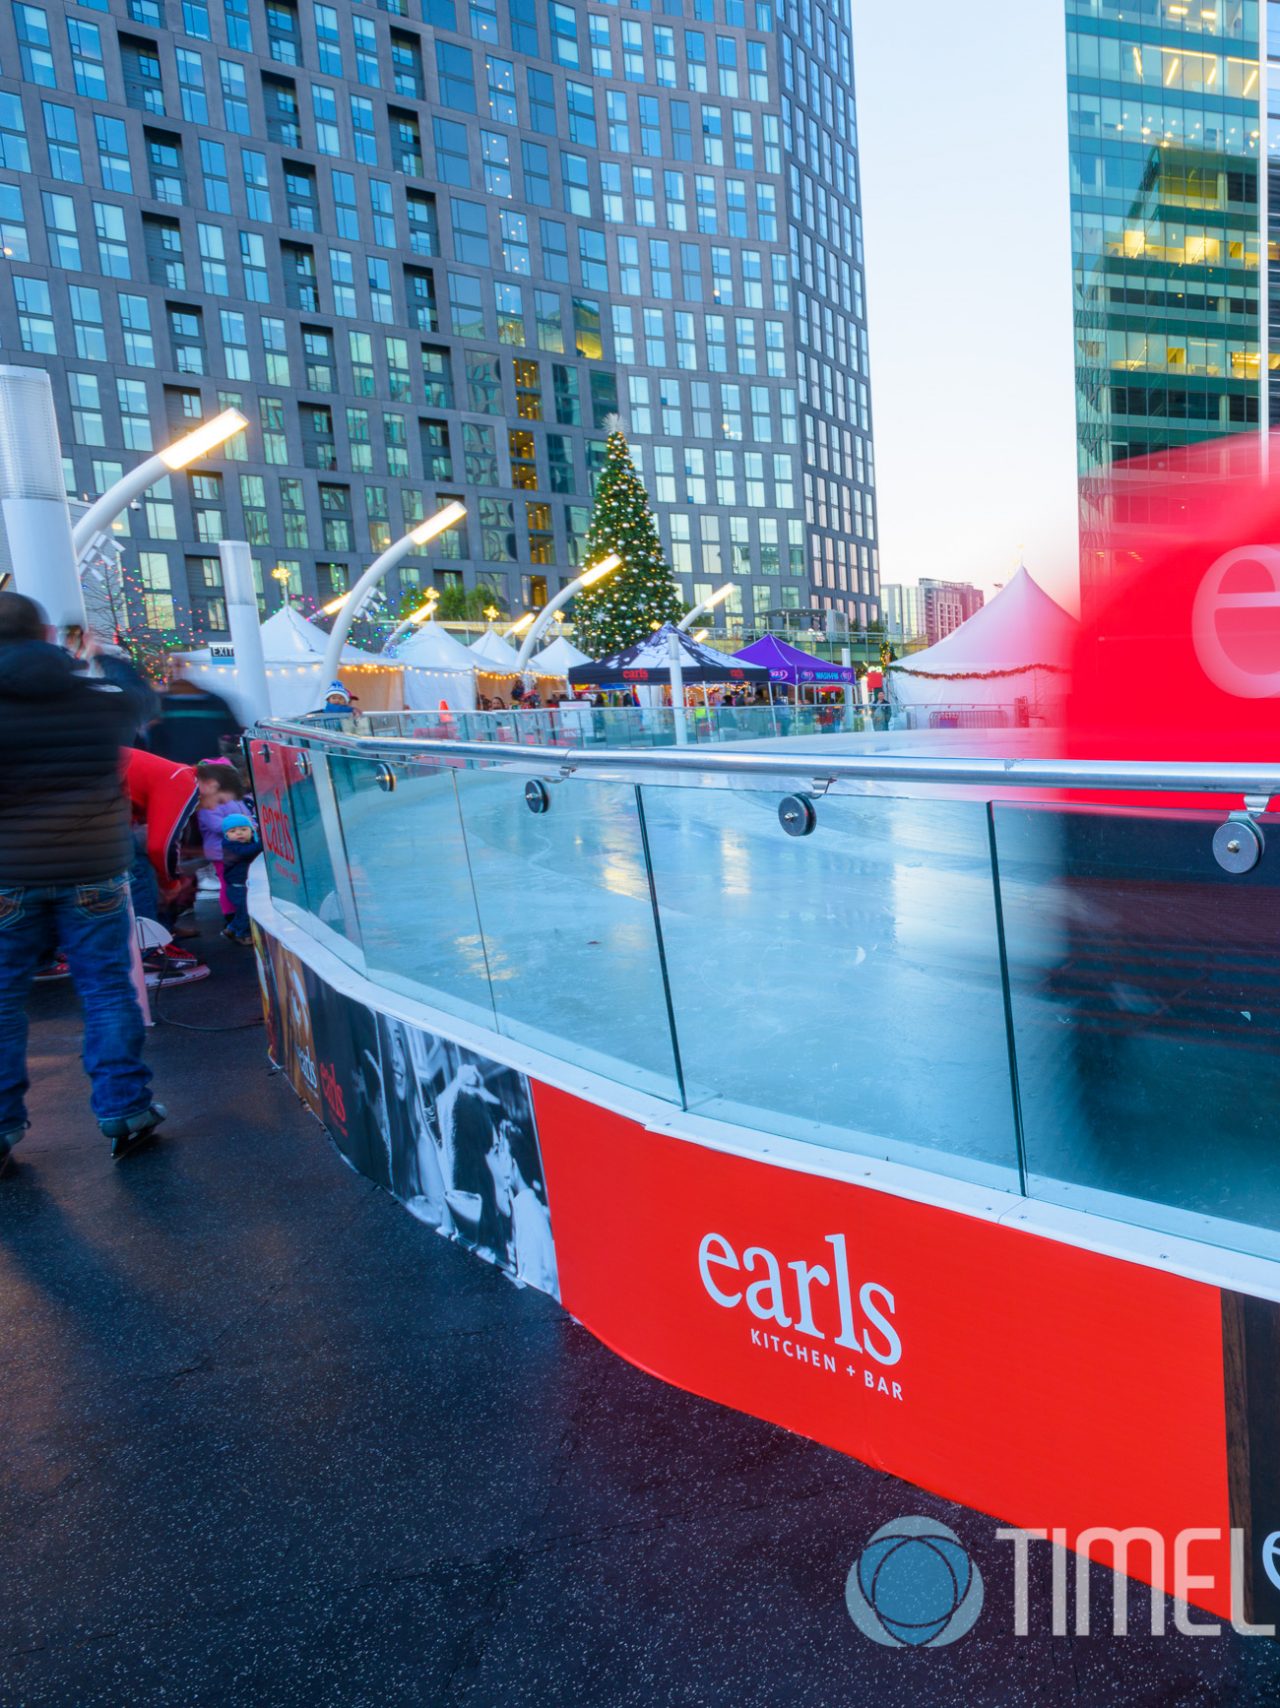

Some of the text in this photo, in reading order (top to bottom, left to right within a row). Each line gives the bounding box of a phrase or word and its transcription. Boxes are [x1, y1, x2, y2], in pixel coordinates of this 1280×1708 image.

[213, 647, 233, 657] EXIT
[261, 789, 295, 865] earls
[698, 1232, 903, 1366] earls
[750, 1328, 837, 1373] KITCHEN
[864, 1370, 904, 1401] BAR
